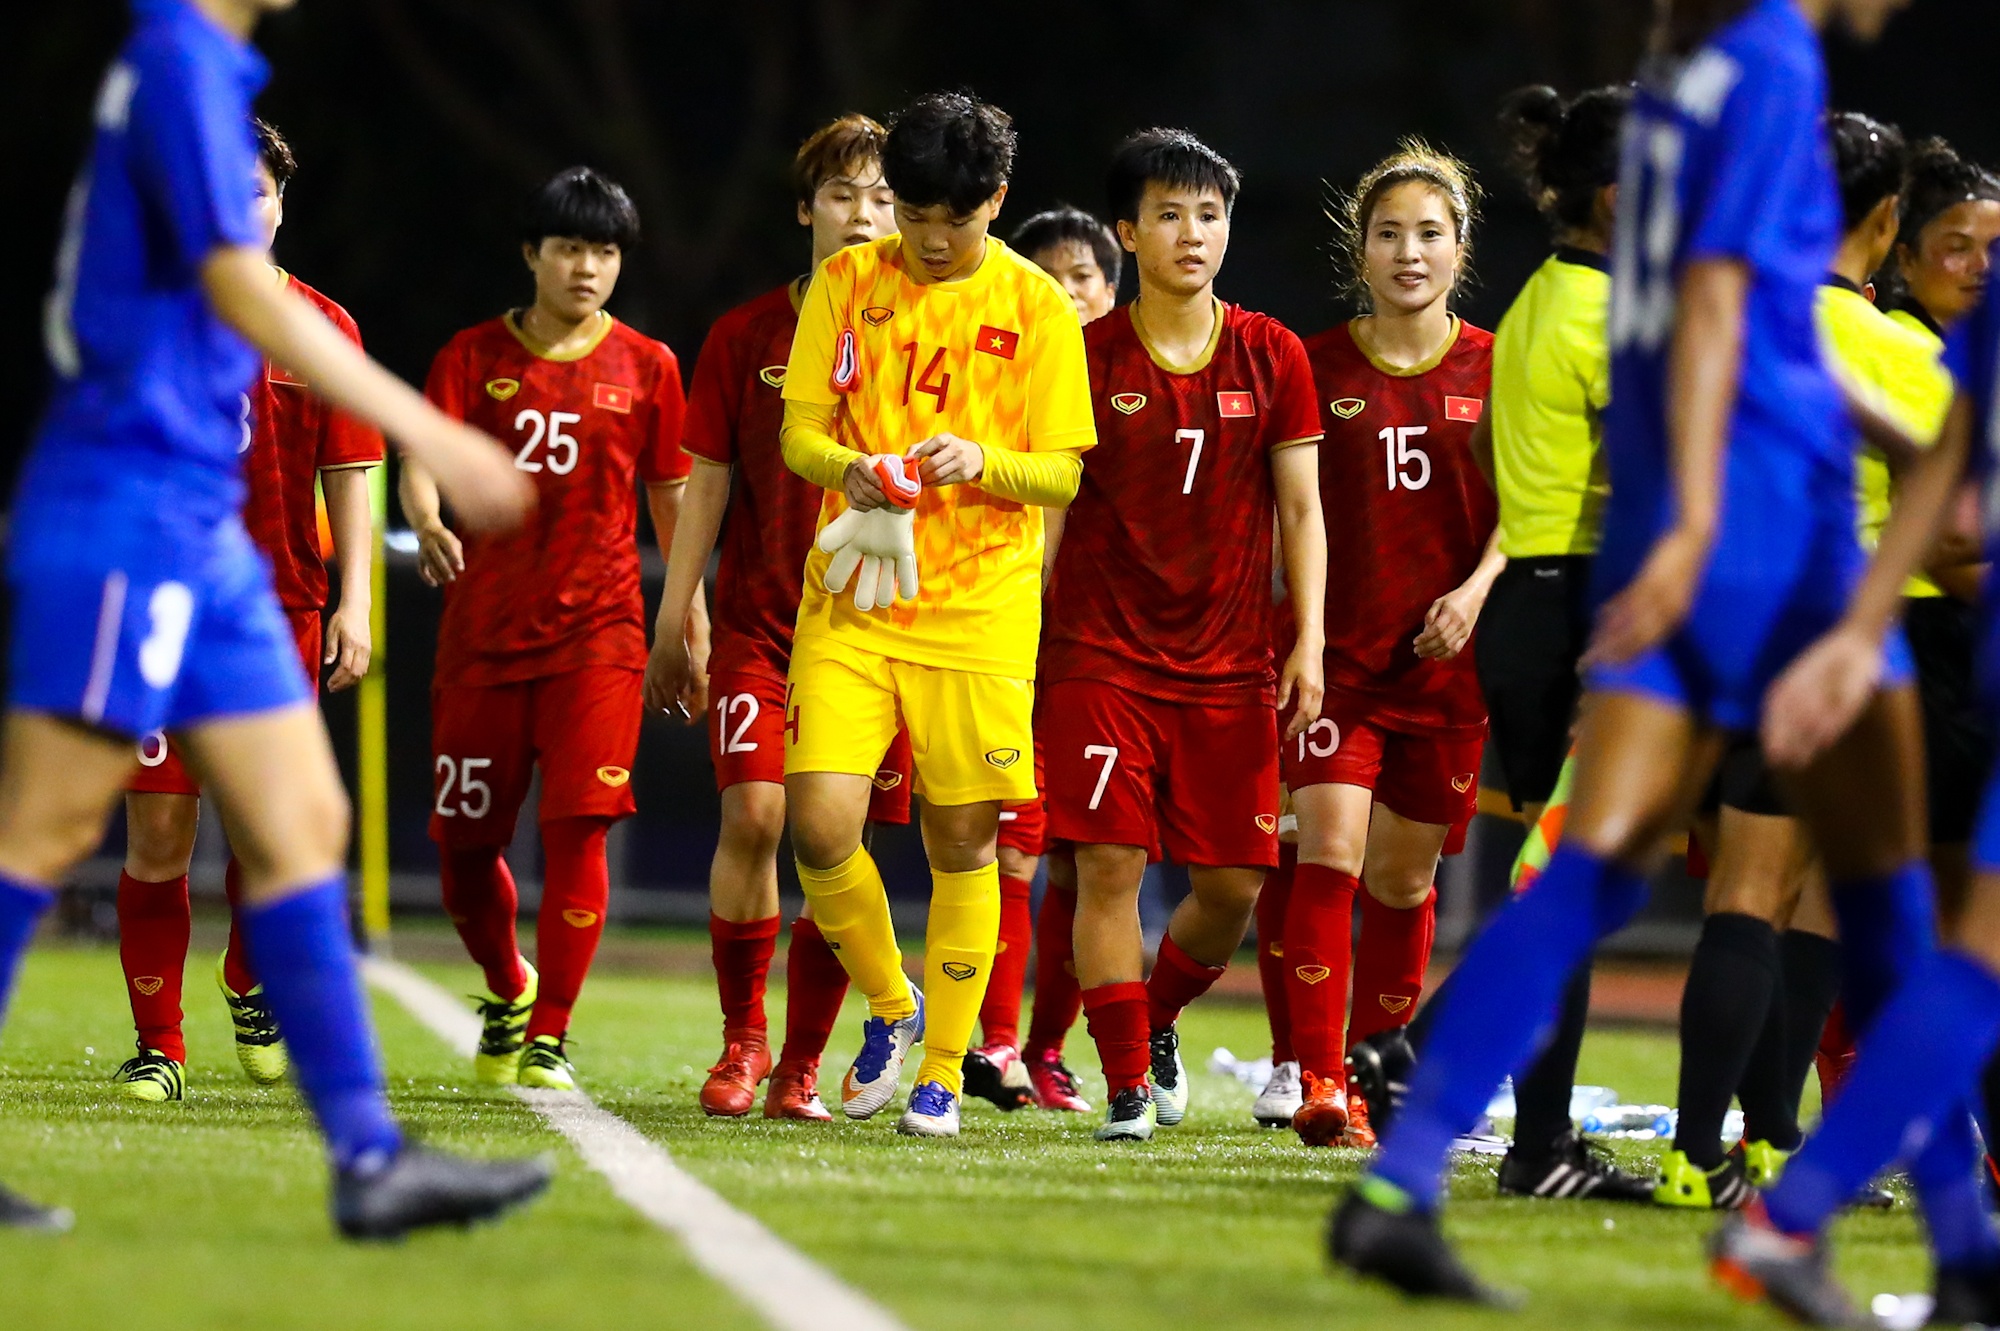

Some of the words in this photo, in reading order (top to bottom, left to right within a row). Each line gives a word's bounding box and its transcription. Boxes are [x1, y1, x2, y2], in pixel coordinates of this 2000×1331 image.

[902, 341, 951, 414] 14
[514, 408, 581, 475] 25
[1175, 428, 1204, 495] 7
[1378, 426, 1431, 491] 15
[717, 692, 759, 756] 12
[435, 754, 492, 819] 25
[1084, 744, 1118, 810] 7
